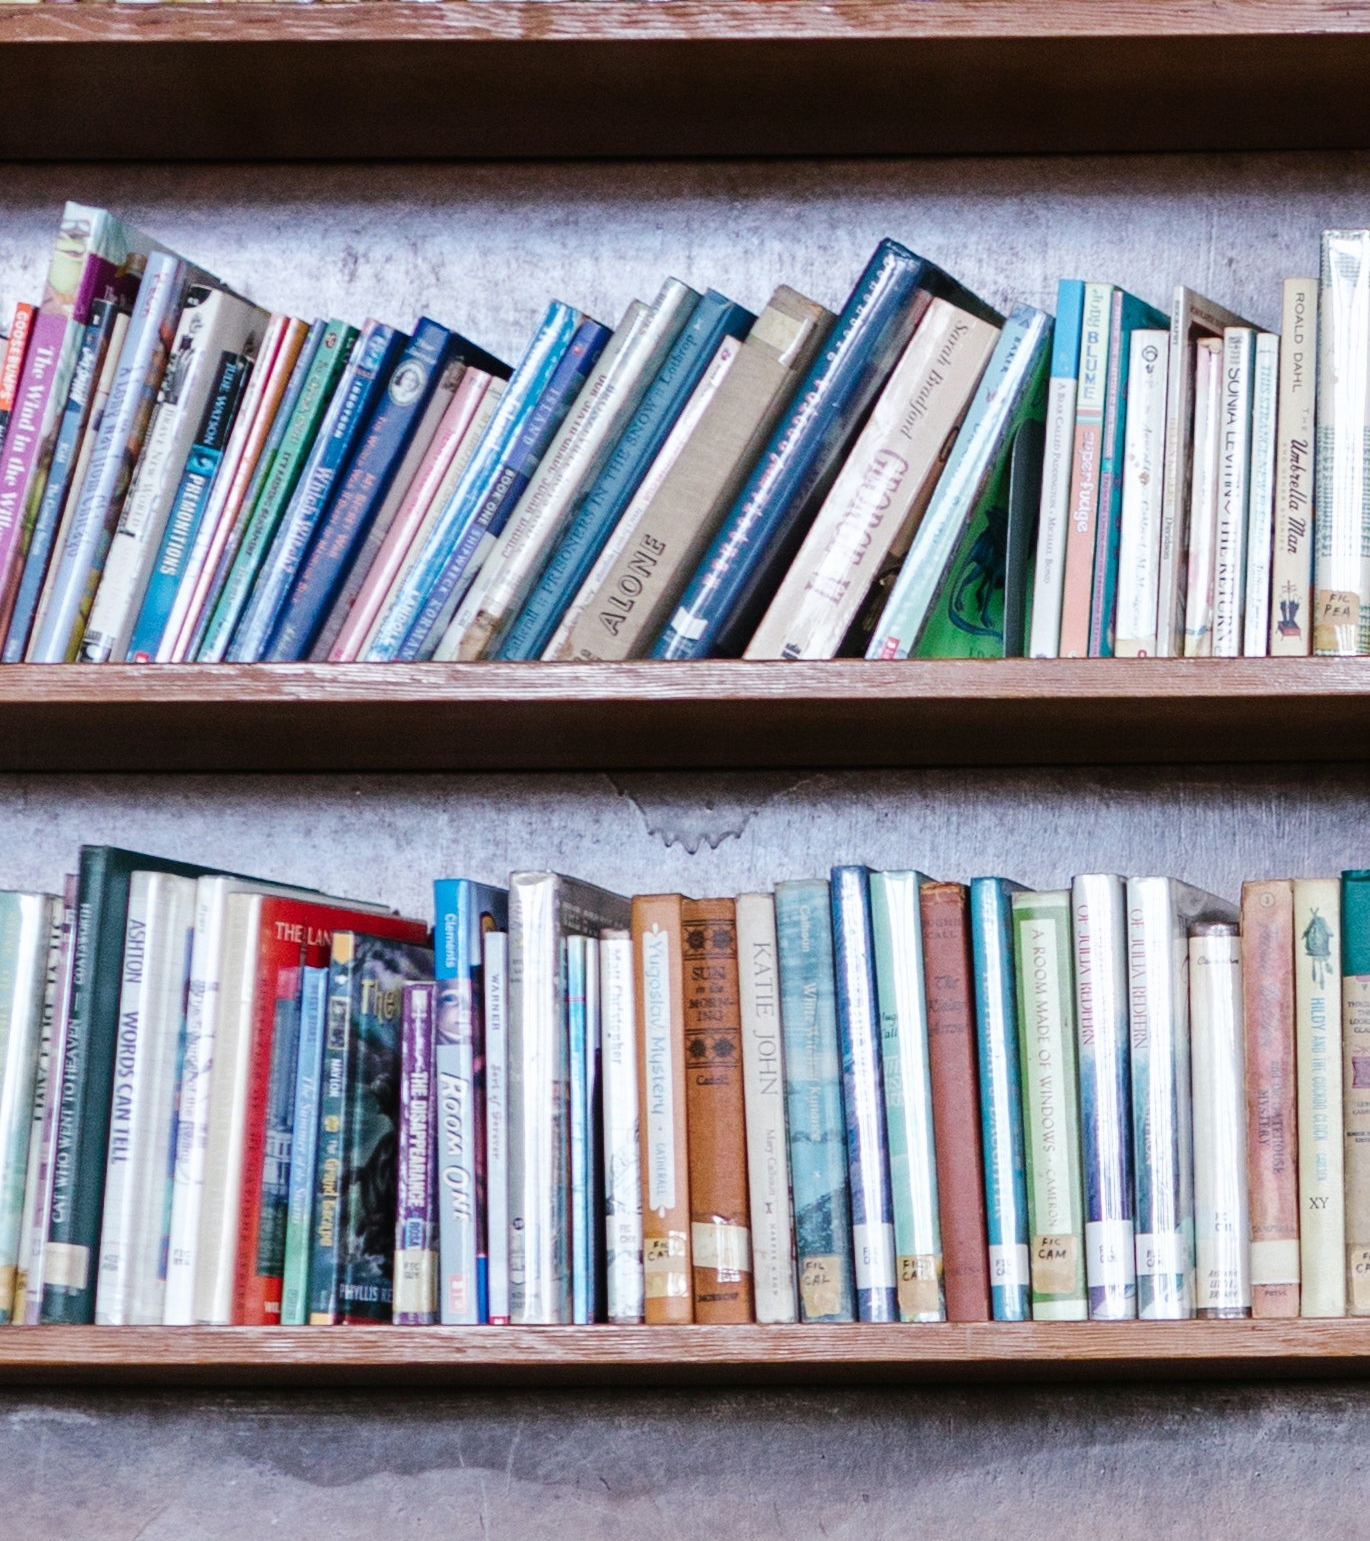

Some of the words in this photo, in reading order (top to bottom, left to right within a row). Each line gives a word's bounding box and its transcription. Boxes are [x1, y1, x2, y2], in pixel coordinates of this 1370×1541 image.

[1293, 292, 1306, 344] ROALD
[1292, 352, 1304, 393] DAHL
[1075, 431, 1096, 534] superfudge
[1288, 439, 1309, 512] Umbrella
[159, 473, 204, 576] PREMONITIONS
[1288, 517, 1307, 555] Man
[599, 534, 666, 637] ALONE
[126, 919, 146, 983] ASHTON
[752, 942, 775, 1018] KATIE
[118, 1010, 140, 1078] WORDS
[754, 1029, 777, 1096] JOHN
[114, 1084, 133, 1121] CAN
[110, 1127, 130, 1165] TELL
